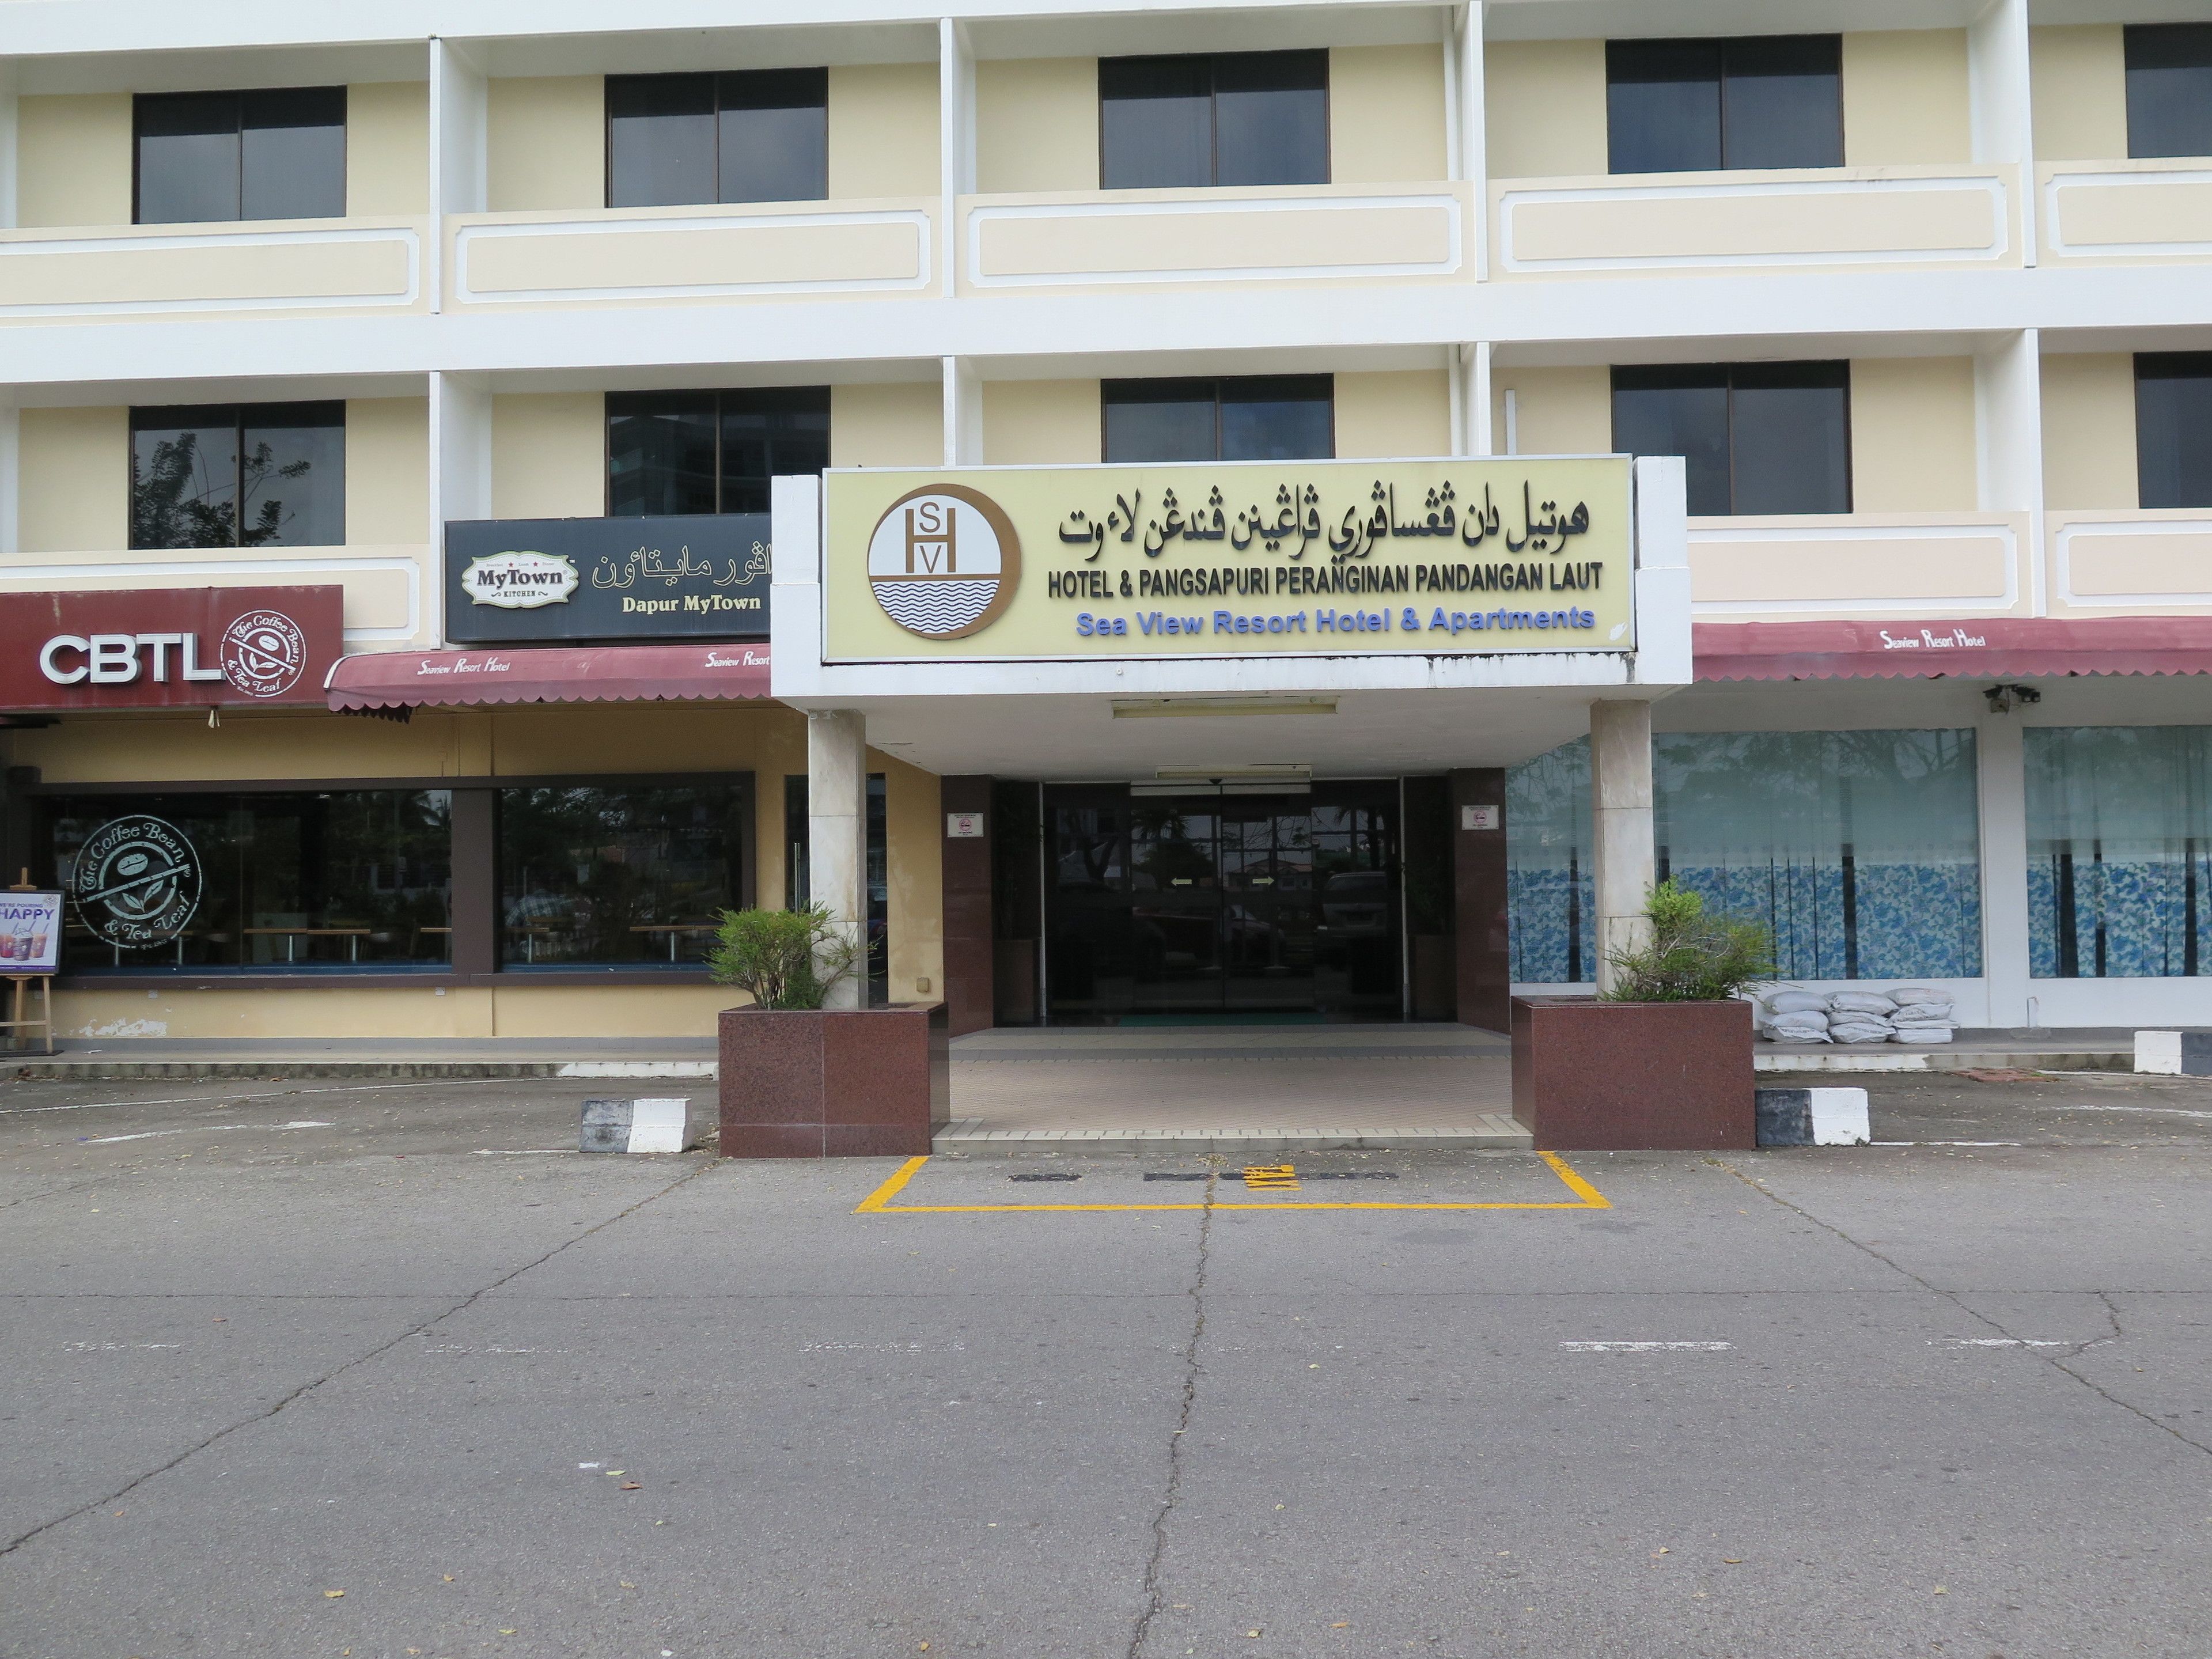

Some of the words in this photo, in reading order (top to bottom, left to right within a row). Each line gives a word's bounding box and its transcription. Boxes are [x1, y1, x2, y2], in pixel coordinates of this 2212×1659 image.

[1462, 482, 1499, 547] دان
[476, 569, 563, 589] MyTown
[1048, 570, 1113, 597] HOTEL
[1120, 570, 1133, 597] &
[1139, 567, 1268, 596] PANGSAPURI
[1276, 565, 1408, 594] PERANGINAN
[1415, 563, 1543, 592] PANDANGAN
[1550, 562, 1603, 590] LAUT
[622, 596, 679, 615] Dapur
[683, 594, 761, 615] MyTown
[1075, 612, 1127, 635] Sea
[1136, 611, 1204, 634] View
[1213, 610, 1307, 634] Resort
[1316, 608, 1391, 632] Hotel
[1400, 607, 1421, 630] &
[1429, 606, 1596, 634] Apartments
[232, 622, 253, 637] The
[253, 615, 288, 632] Coffee
[287, 628, 300, 664] Bean
[1880, 630, 1919, 650] Seaview
[1921, 630, 1955, 648] Resort
[1953, 629, 1986, 647] Hotel
[40, 632, 226, 684] CBTL
[416, 660, 451, 675] Seaview
[454, 658, 481, 673] Resort
[483, 657, 511, 672] Hotel
[704, 652, 740, 668] Seaview
[743, 651, 770, 666] Resort
[228, 659, 238, 671] &
[234, 668, 250, 688] Tea
[252, 678, 282, 692] Leaf
[79, 861, 98, 893] The
[90, 825, 141, 859] Coffee
[143, 823, 185, 863] Bean
[0, 908, 55, 920] HAPPY
[104, 919, 118, 935] &
[122, 923, 152, 940] Tea
[153, 891, 190, 930] Leaf
